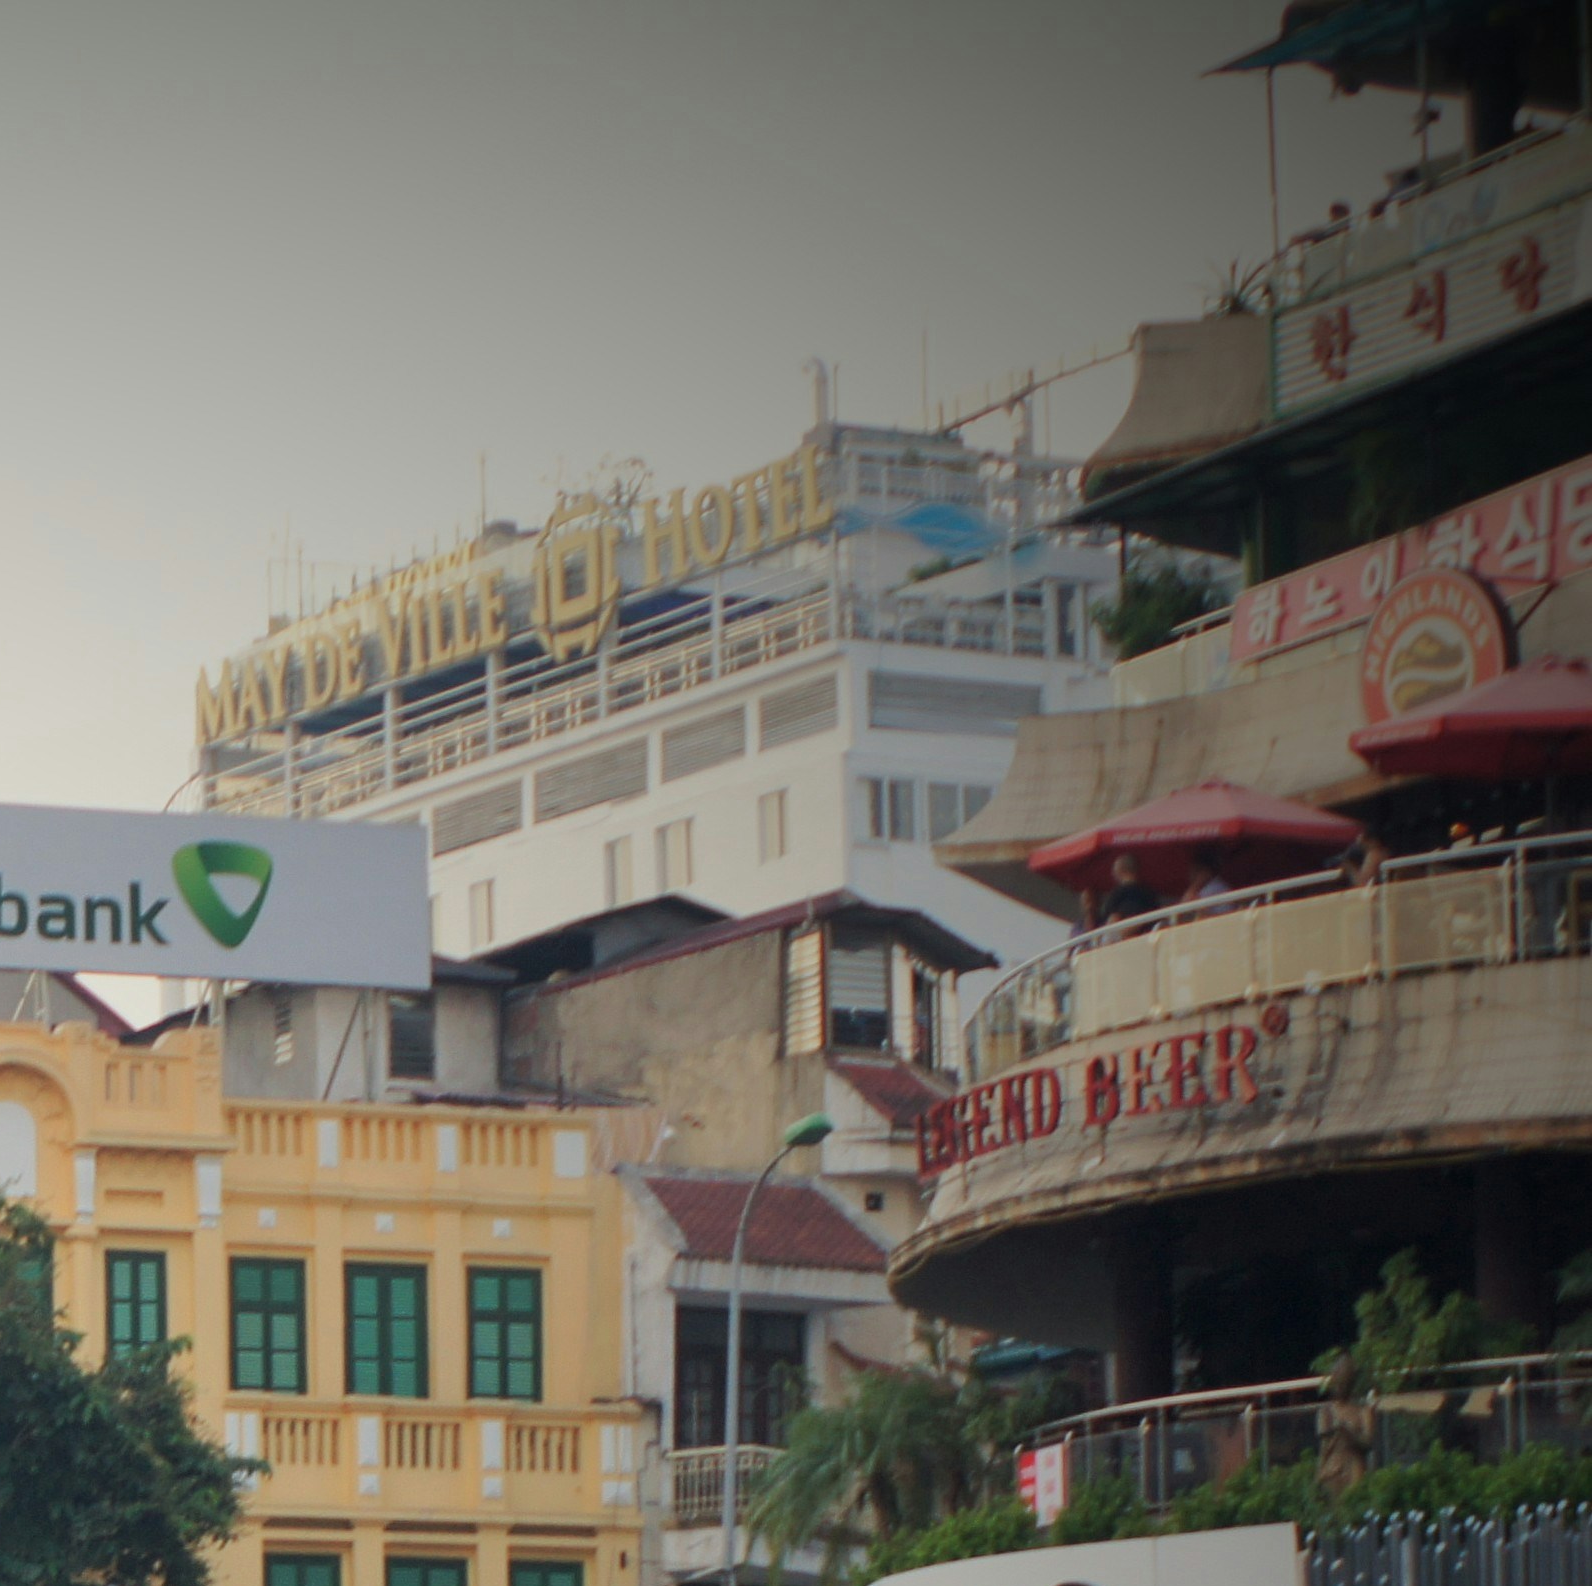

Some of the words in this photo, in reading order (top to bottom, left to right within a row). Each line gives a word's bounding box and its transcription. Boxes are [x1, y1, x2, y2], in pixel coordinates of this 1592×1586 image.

[196, 643, 294, 749] MAY
[303, 617, 365, 712] DE
[376, 568, 508, 677] VILLE
[641, 443, 833, 589] HOTEL
[1248, 539, 1398, 643] 하노이
[1364, 582, 1492, 683] HIGHLANDS
[915, 1067, 1062, 1180] LEGEND
